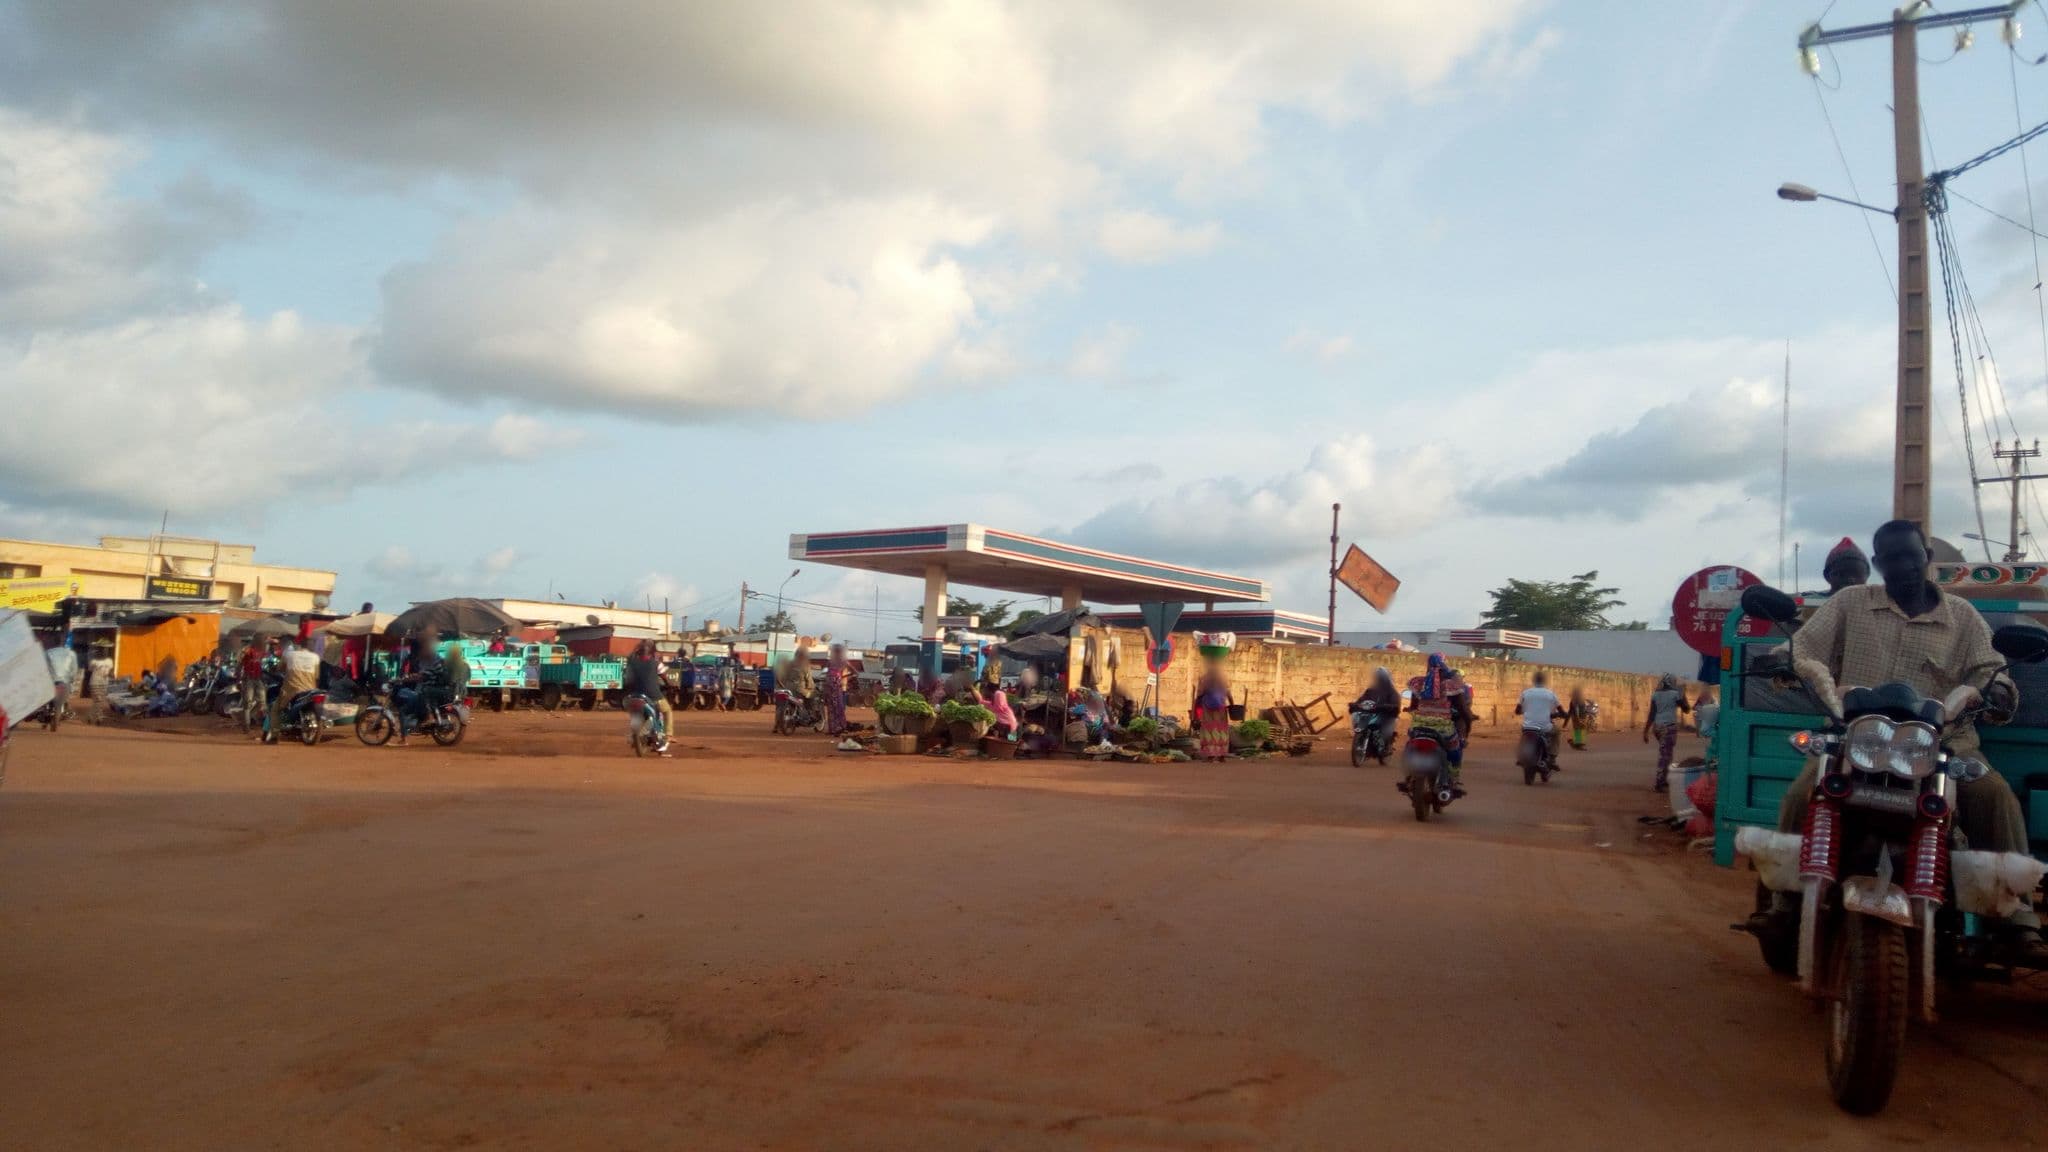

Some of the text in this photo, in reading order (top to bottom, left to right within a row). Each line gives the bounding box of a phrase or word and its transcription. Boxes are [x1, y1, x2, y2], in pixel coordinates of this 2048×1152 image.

[152, 579, 198, 589] WESTERN
[165, 586, 198, 595] UNION
[1692, 611, 1725, 621] JEUD
